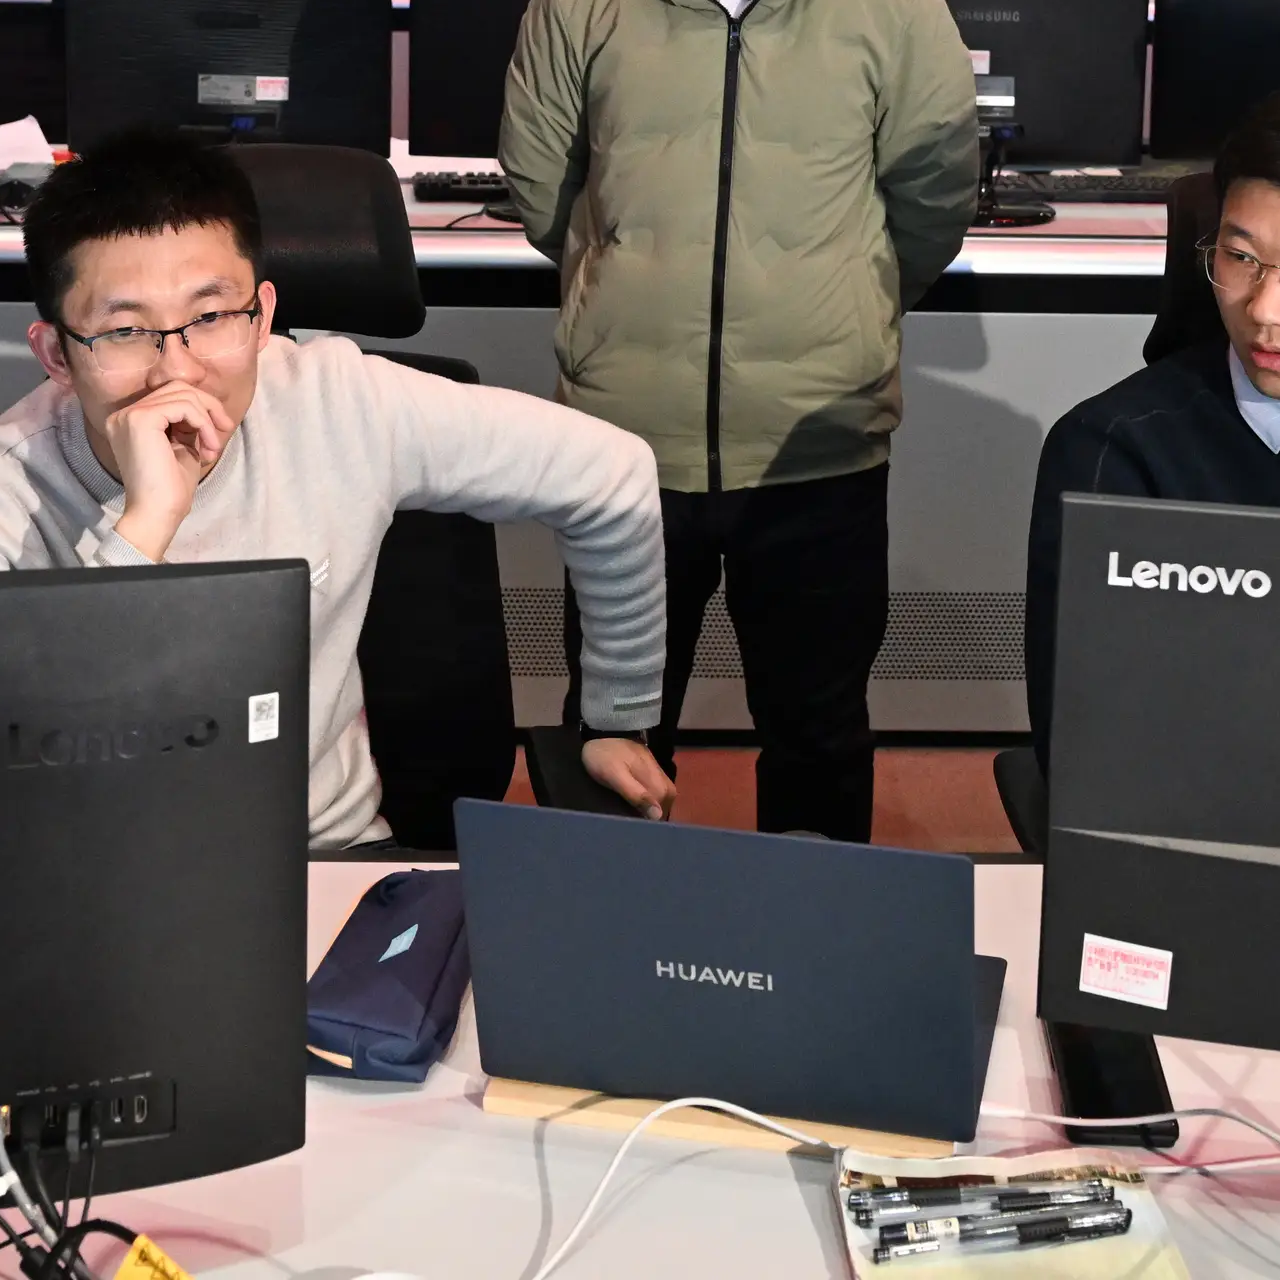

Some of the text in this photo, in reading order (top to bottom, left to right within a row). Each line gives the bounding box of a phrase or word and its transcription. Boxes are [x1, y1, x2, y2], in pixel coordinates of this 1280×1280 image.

[956, 8, 1021, 23] SAMSUNG
[1107, 551, 1273, 599] Lenovo
[655, 959, 775, 993] HUAWEI
